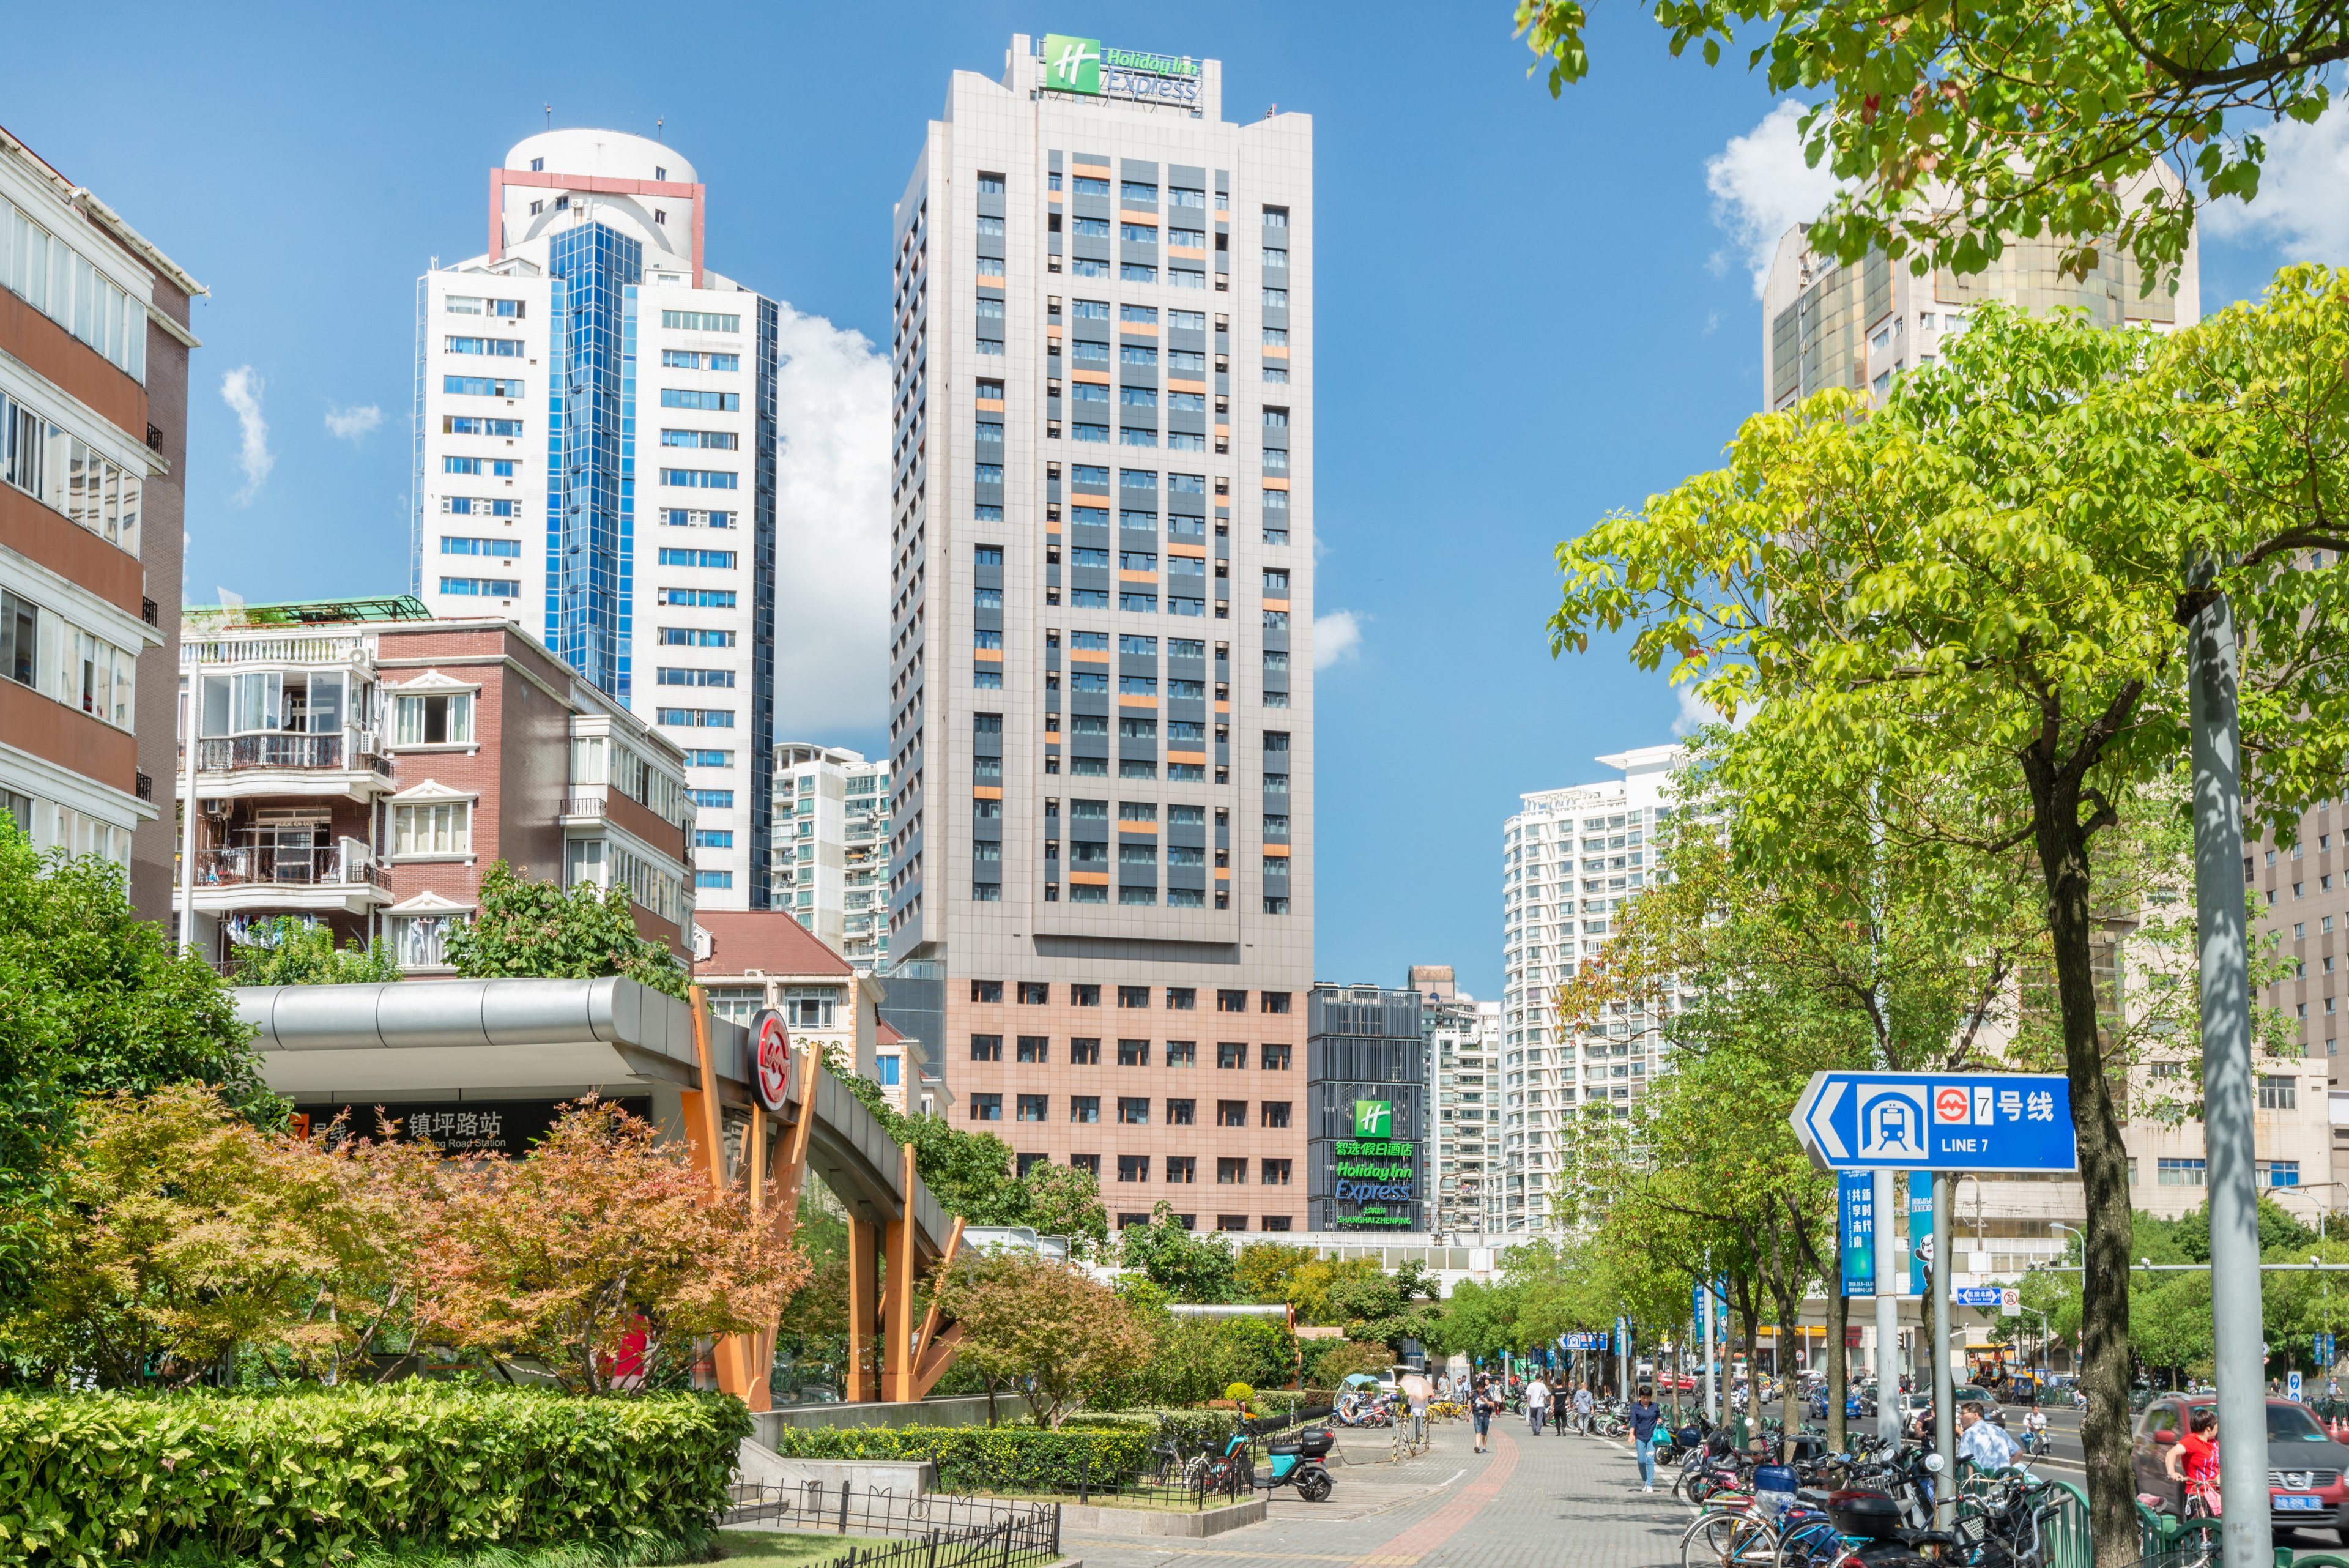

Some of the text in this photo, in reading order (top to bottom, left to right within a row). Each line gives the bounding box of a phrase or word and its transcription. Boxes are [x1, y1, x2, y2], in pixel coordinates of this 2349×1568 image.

[1107, 48, 1198, 76] Holiday Inn
[1108, 69, 1197, 100] Express
[1977, 1090, 2054, 1123] 7 号线
[409, 1111, 502, 1137] 镇坪路站
[448, 1139, 472, 1148] Road
[475, 1139, 506, 1148] Station
[1335, 1142, 1413, 1156] 智选假日酒店
[1941, 1138, 1989, 1153] LINE 7
[1337, 1162, 1412, 1181] Holiday Inn
[1335, 1178, 1411, 1205] Express
[1852, 1189, 1862, 1248] 共享未来
[1862, 1189, 1871, 1232] 新时代
